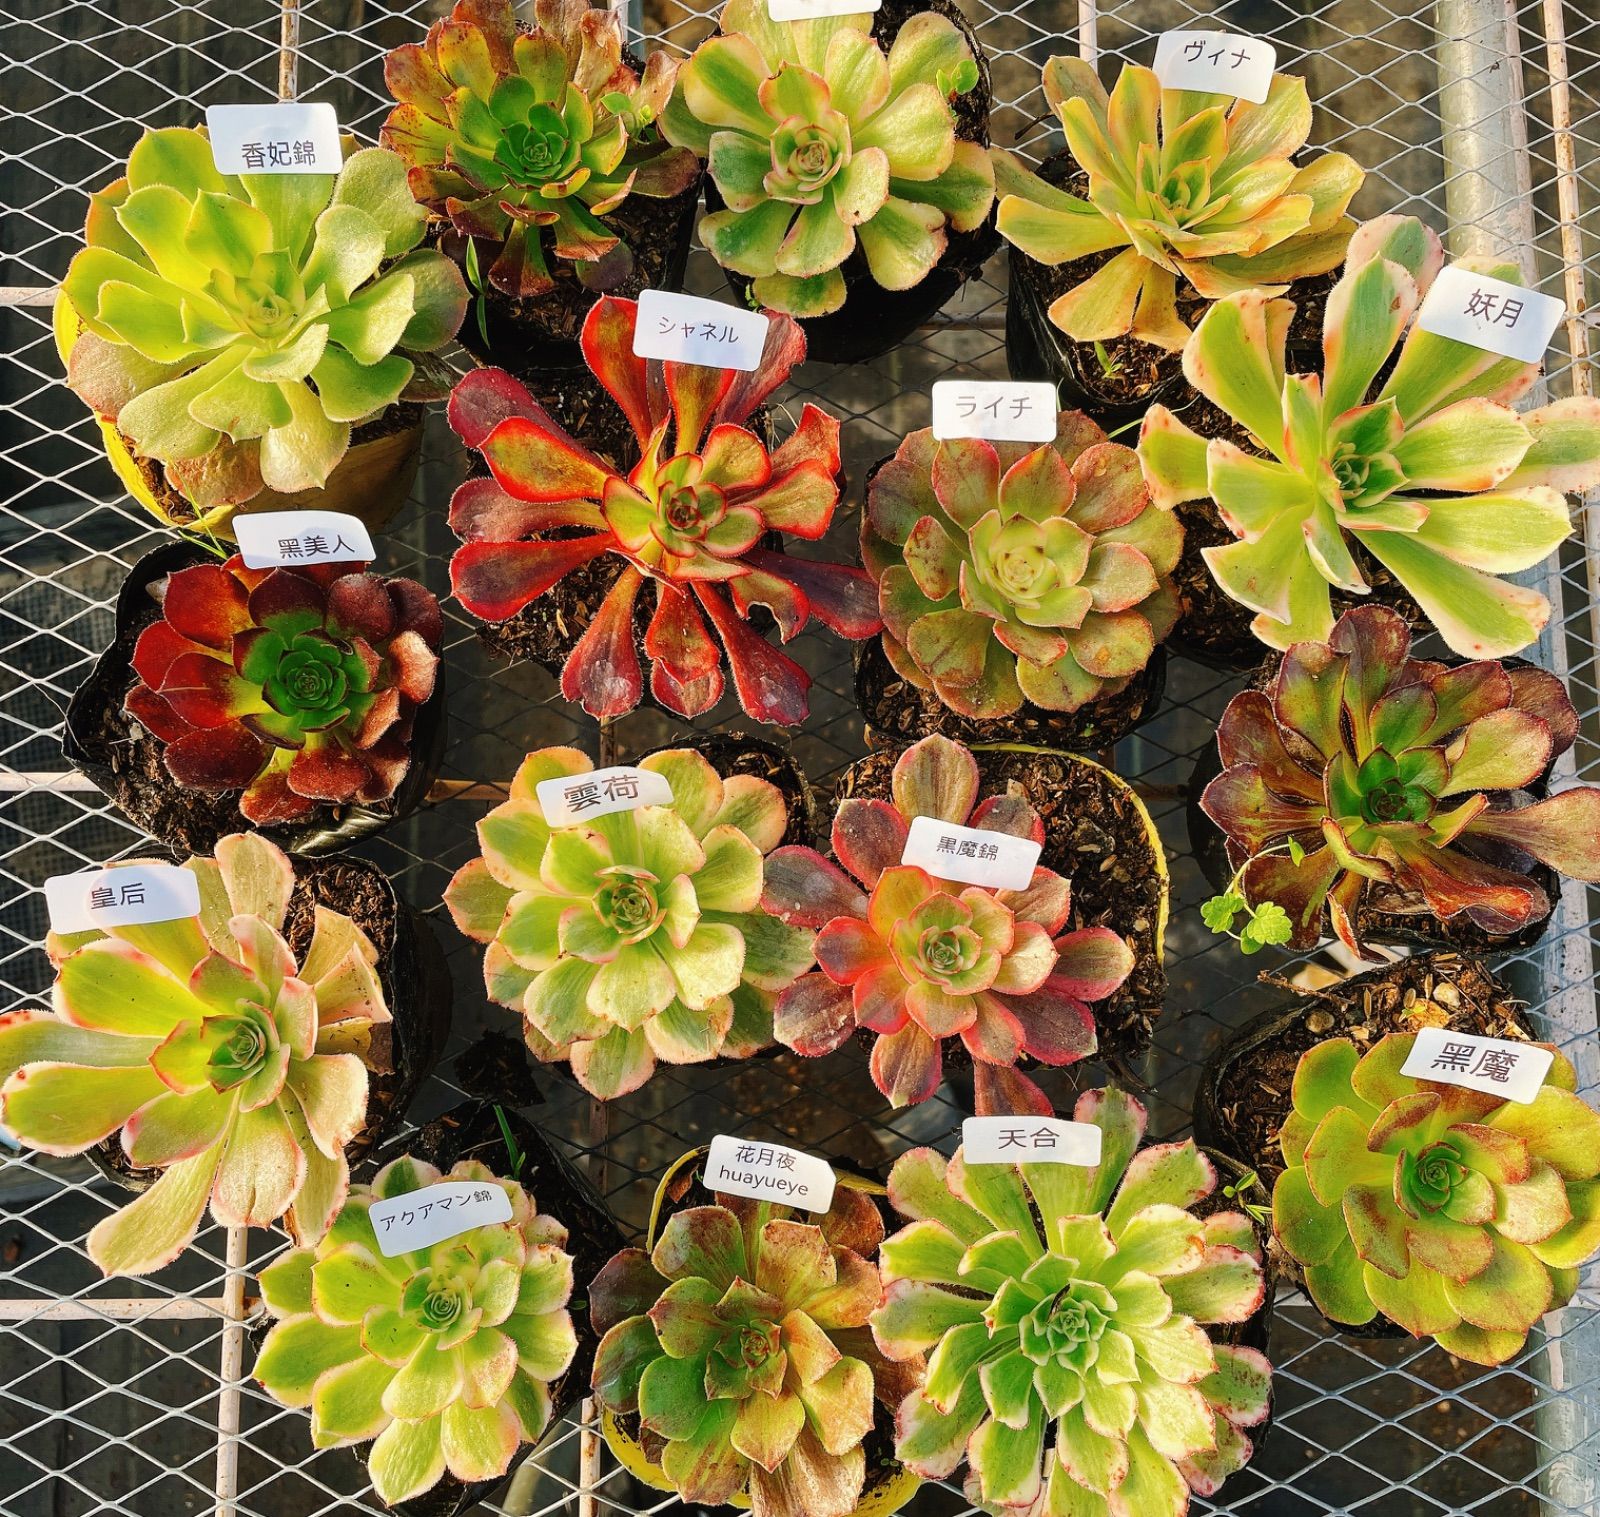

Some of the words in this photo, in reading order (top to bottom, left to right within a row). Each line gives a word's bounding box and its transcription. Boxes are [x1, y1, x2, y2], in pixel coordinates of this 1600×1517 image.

[1183, 40, 1251, 69] ヴィナ
[241, 140, 316, 169] 香妃錦
[1464, 288, 1524, 328] 妖月
[658, 316, 739, 343] シャネル
[955, 395, 1032, 420] ライチ
[278, 534, 355, 559] 黑美人
[564, 775, 640, 813] 雲荷
[91, 882, 146, 910] 皇后
[1430, 1042, 1519, 1083] 黑魔
[997, 1127, 1061, 1149] 天合
[735, 1145, 797, 1172] 花月夜
[719, 1165, 808, 1196] huayueye
[380, 1190, 492, 1231] アクアマン錦
